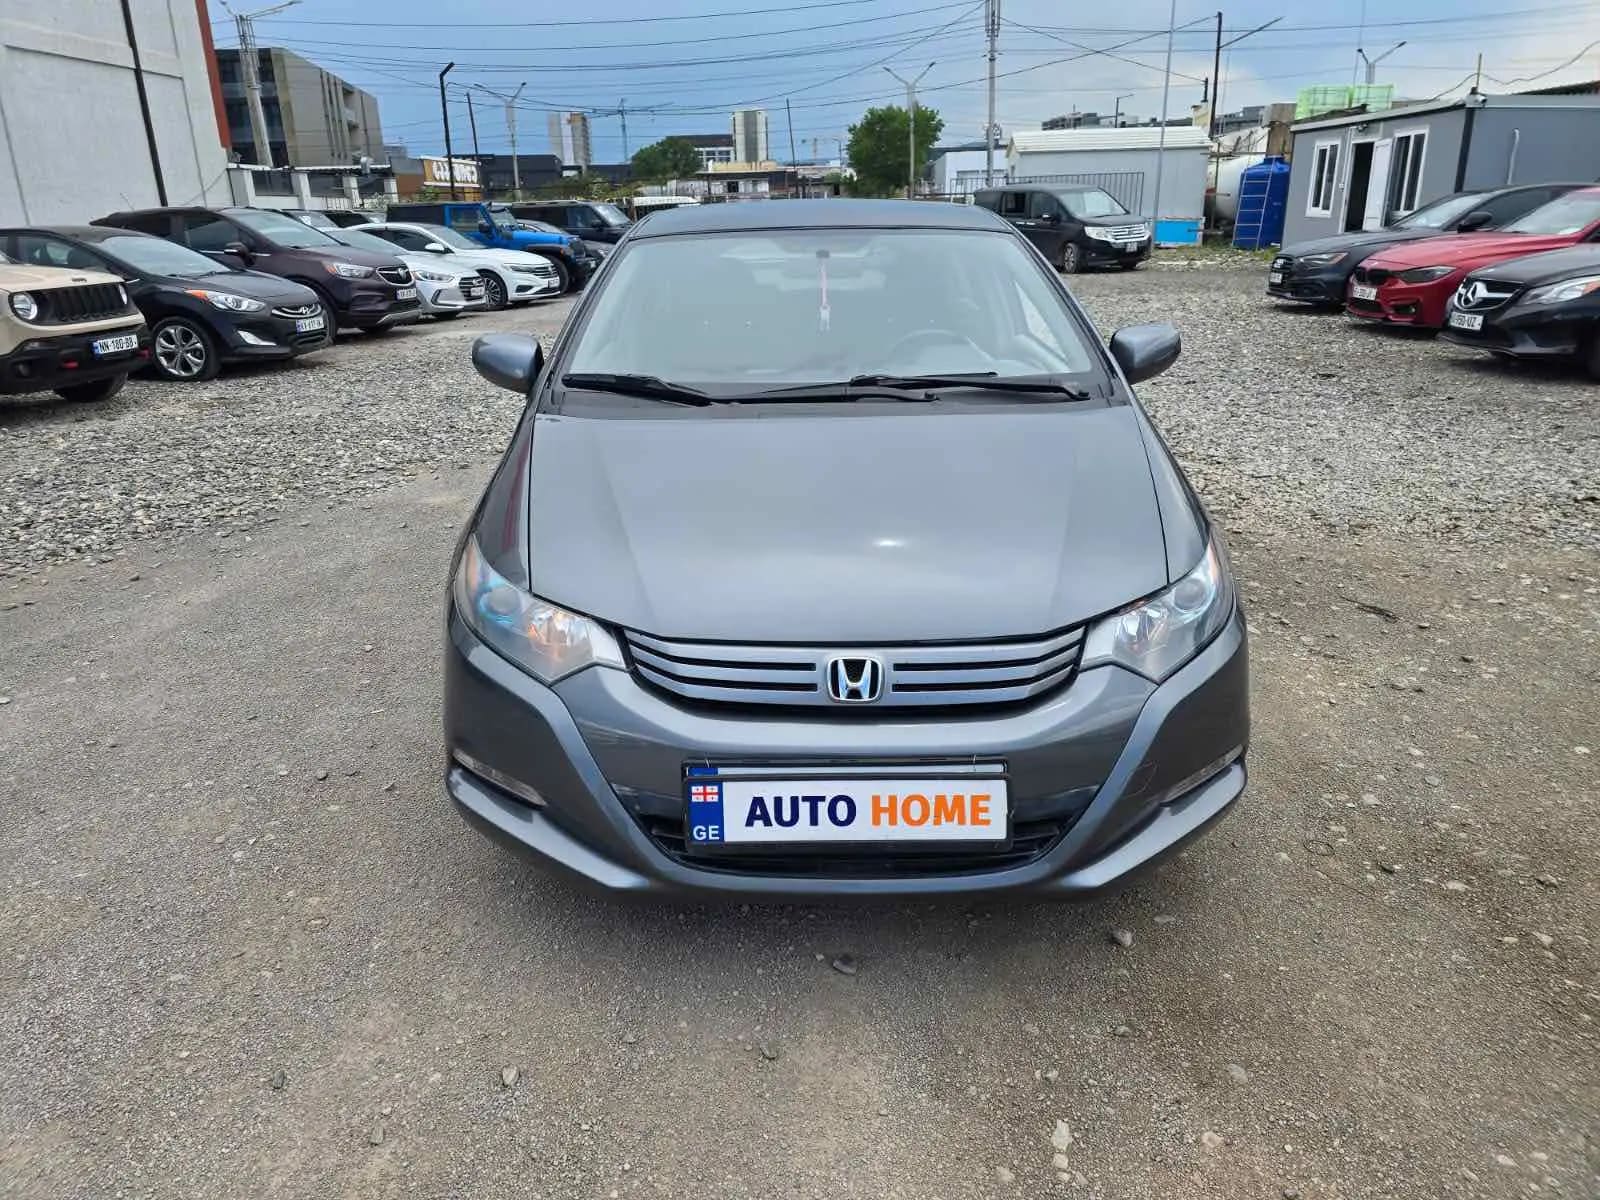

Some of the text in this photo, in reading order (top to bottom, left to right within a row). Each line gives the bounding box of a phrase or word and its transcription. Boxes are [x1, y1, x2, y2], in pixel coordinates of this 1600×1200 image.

[744, 793, 992, 828] AUTO HOME
[692, 824, 720, 842] GE
